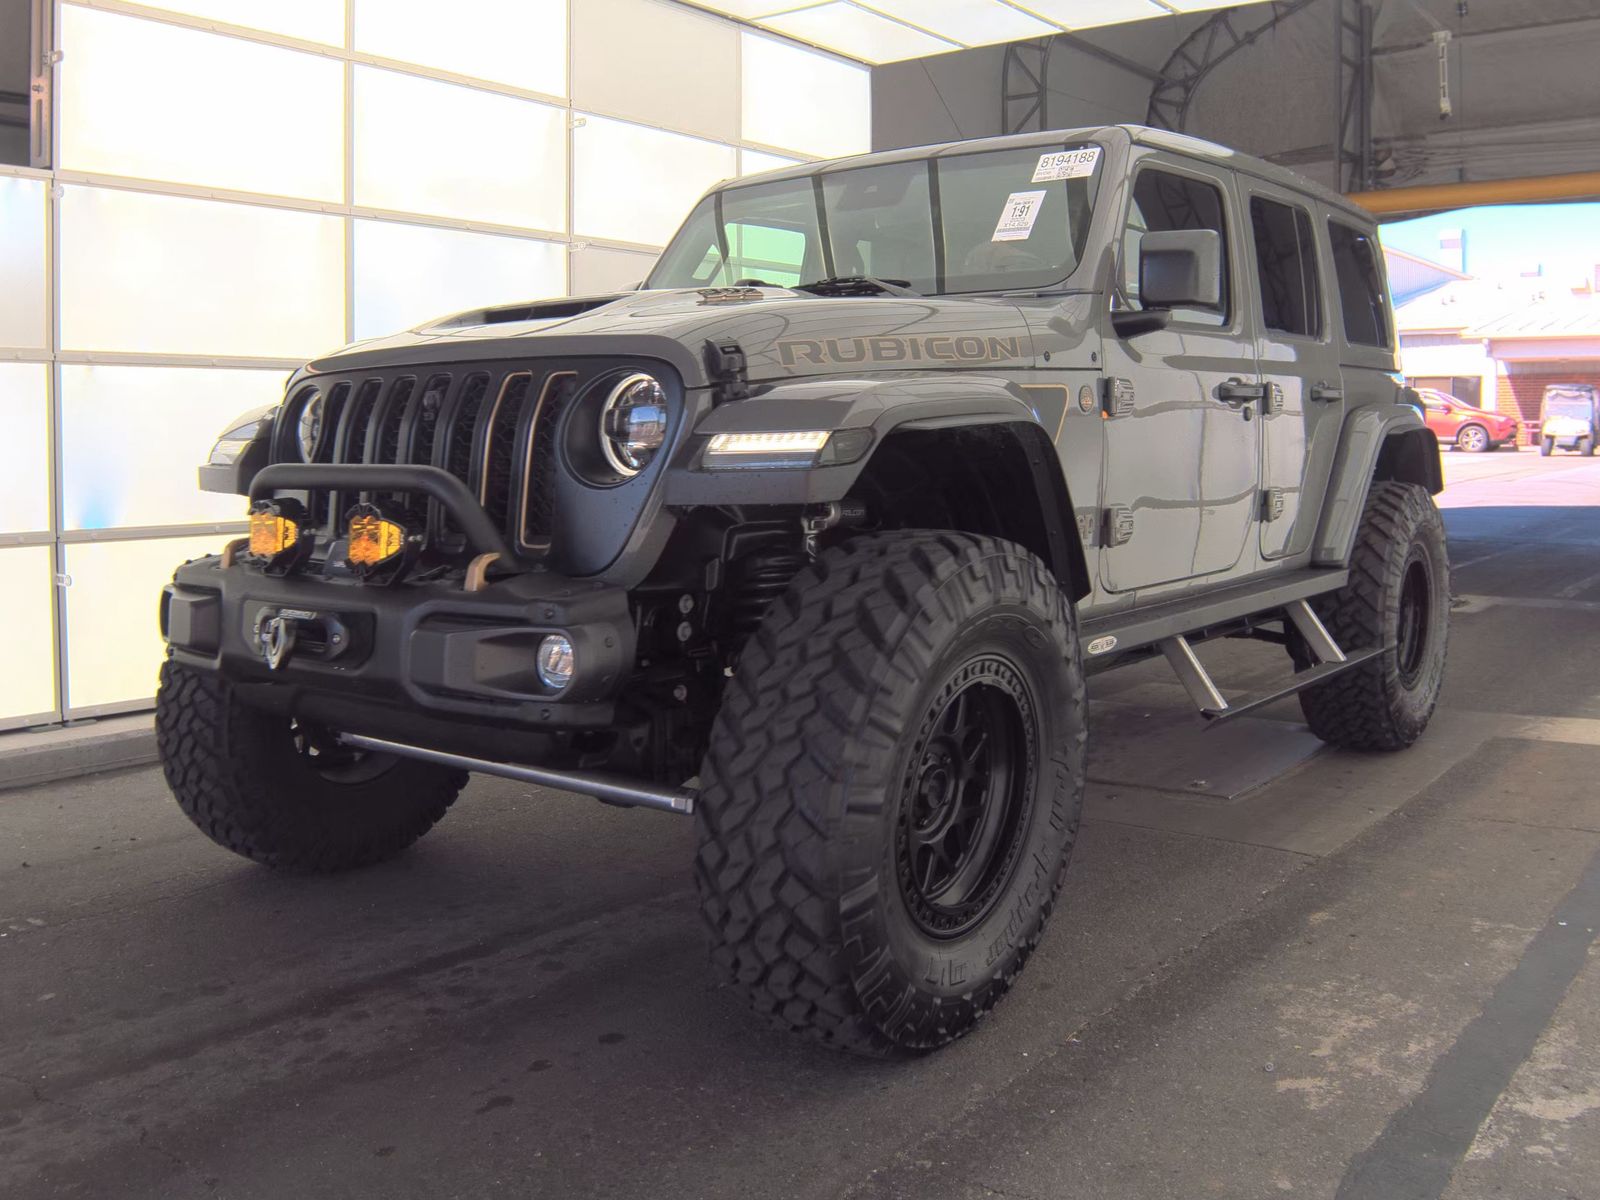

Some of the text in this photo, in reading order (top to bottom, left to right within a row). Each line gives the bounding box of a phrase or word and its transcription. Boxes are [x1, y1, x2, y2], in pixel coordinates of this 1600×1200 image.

[1040, 151, 1096, 168] 8194188
[1011, 204, 1031, 218] 1:91
[776, 336, 1022, 366] RUBICON
